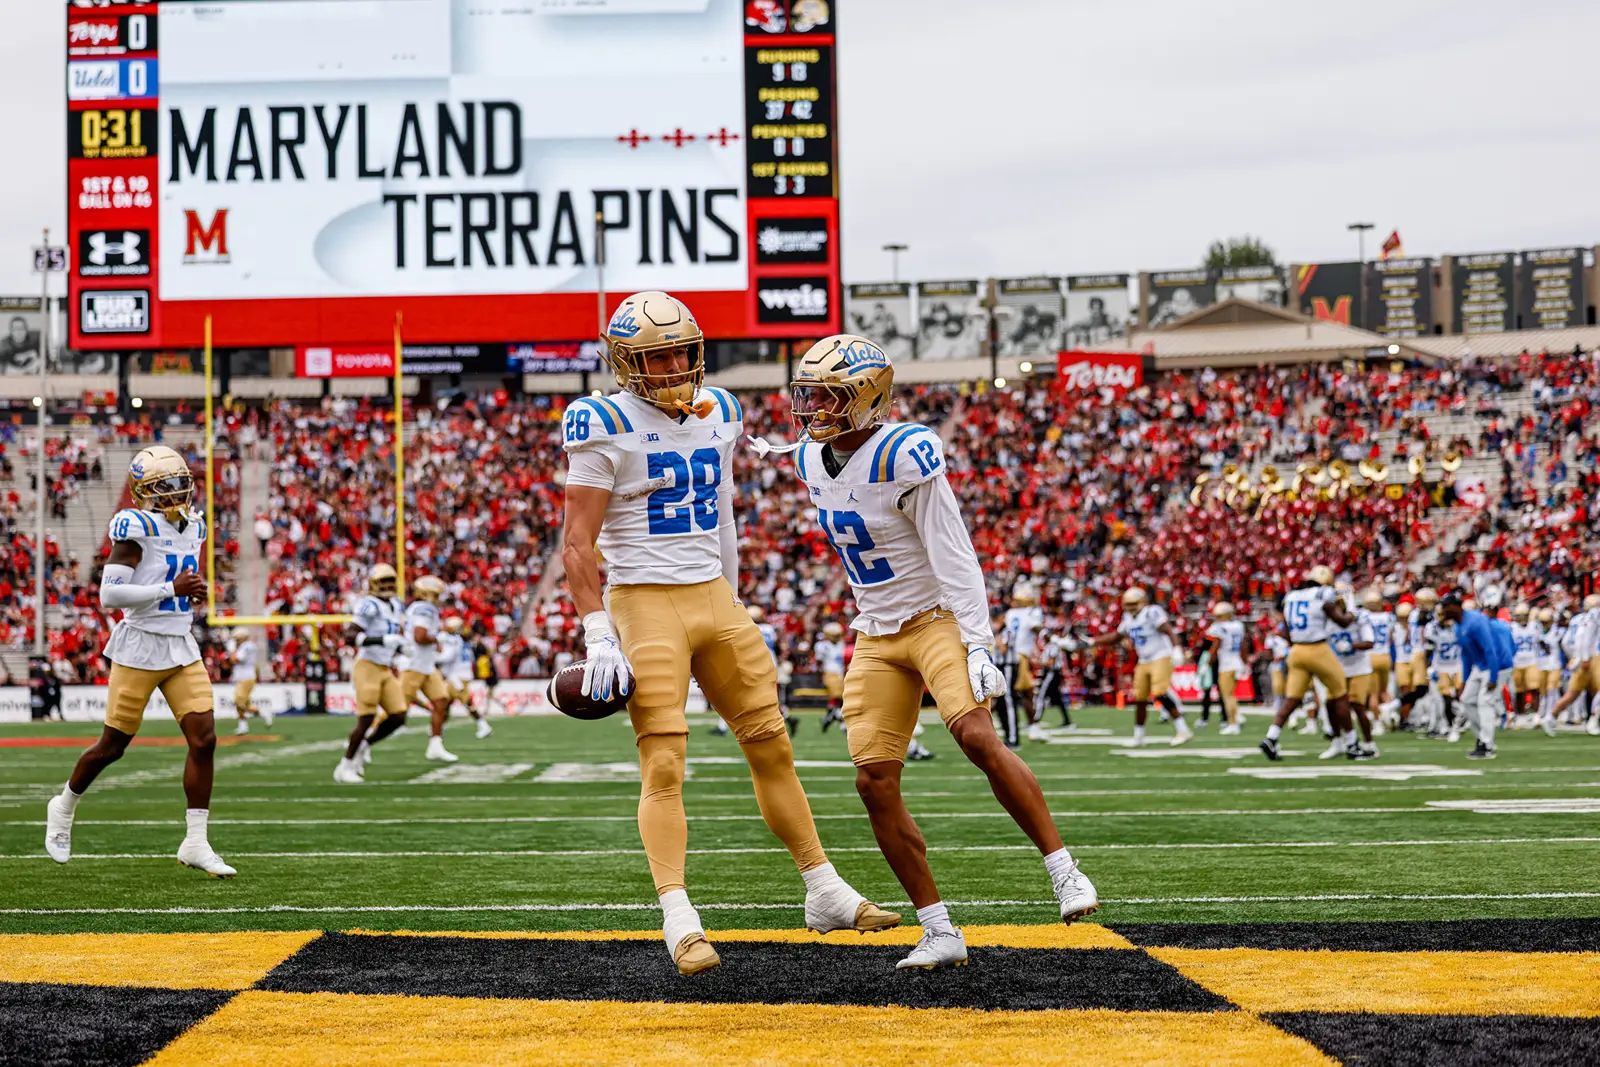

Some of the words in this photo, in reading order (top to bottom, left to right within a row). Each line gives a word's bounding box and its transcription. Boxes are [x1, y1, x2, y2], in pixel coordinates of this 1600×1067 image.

[128, 14, 147, 50] 0
[128, 60, 147, 96] 0
[772, 62, 785, 82] 9
[765, 100, 785, 120] 37
[791, 100, 812, 120] 42
[81, 109, 142, 147] 0:31
[168, 101, 522, 182] MARYLAND
[773, 136, 786, 156] 0
[792, 136, 805, 156] 0
[82, 176, 112, 193] 1ST
[774, 175, 787, 195] 3
[792, 175, 805, 195] 3
[183, 208, 230, 263] M
[383, 189, 740, 267] TERRAPINS
[335, 353, 392, 369] TOYOTA
[838, 343, 886, 366] Ucla
[565, 409, 592, 442] 28
[908, 439, 941, 478] 12
[647, 447, 722, 535] 28
[113, 517, 130, 539] 18
[818, 508, 896, 585] 12
[1288, 600, 1310, 631] 15
